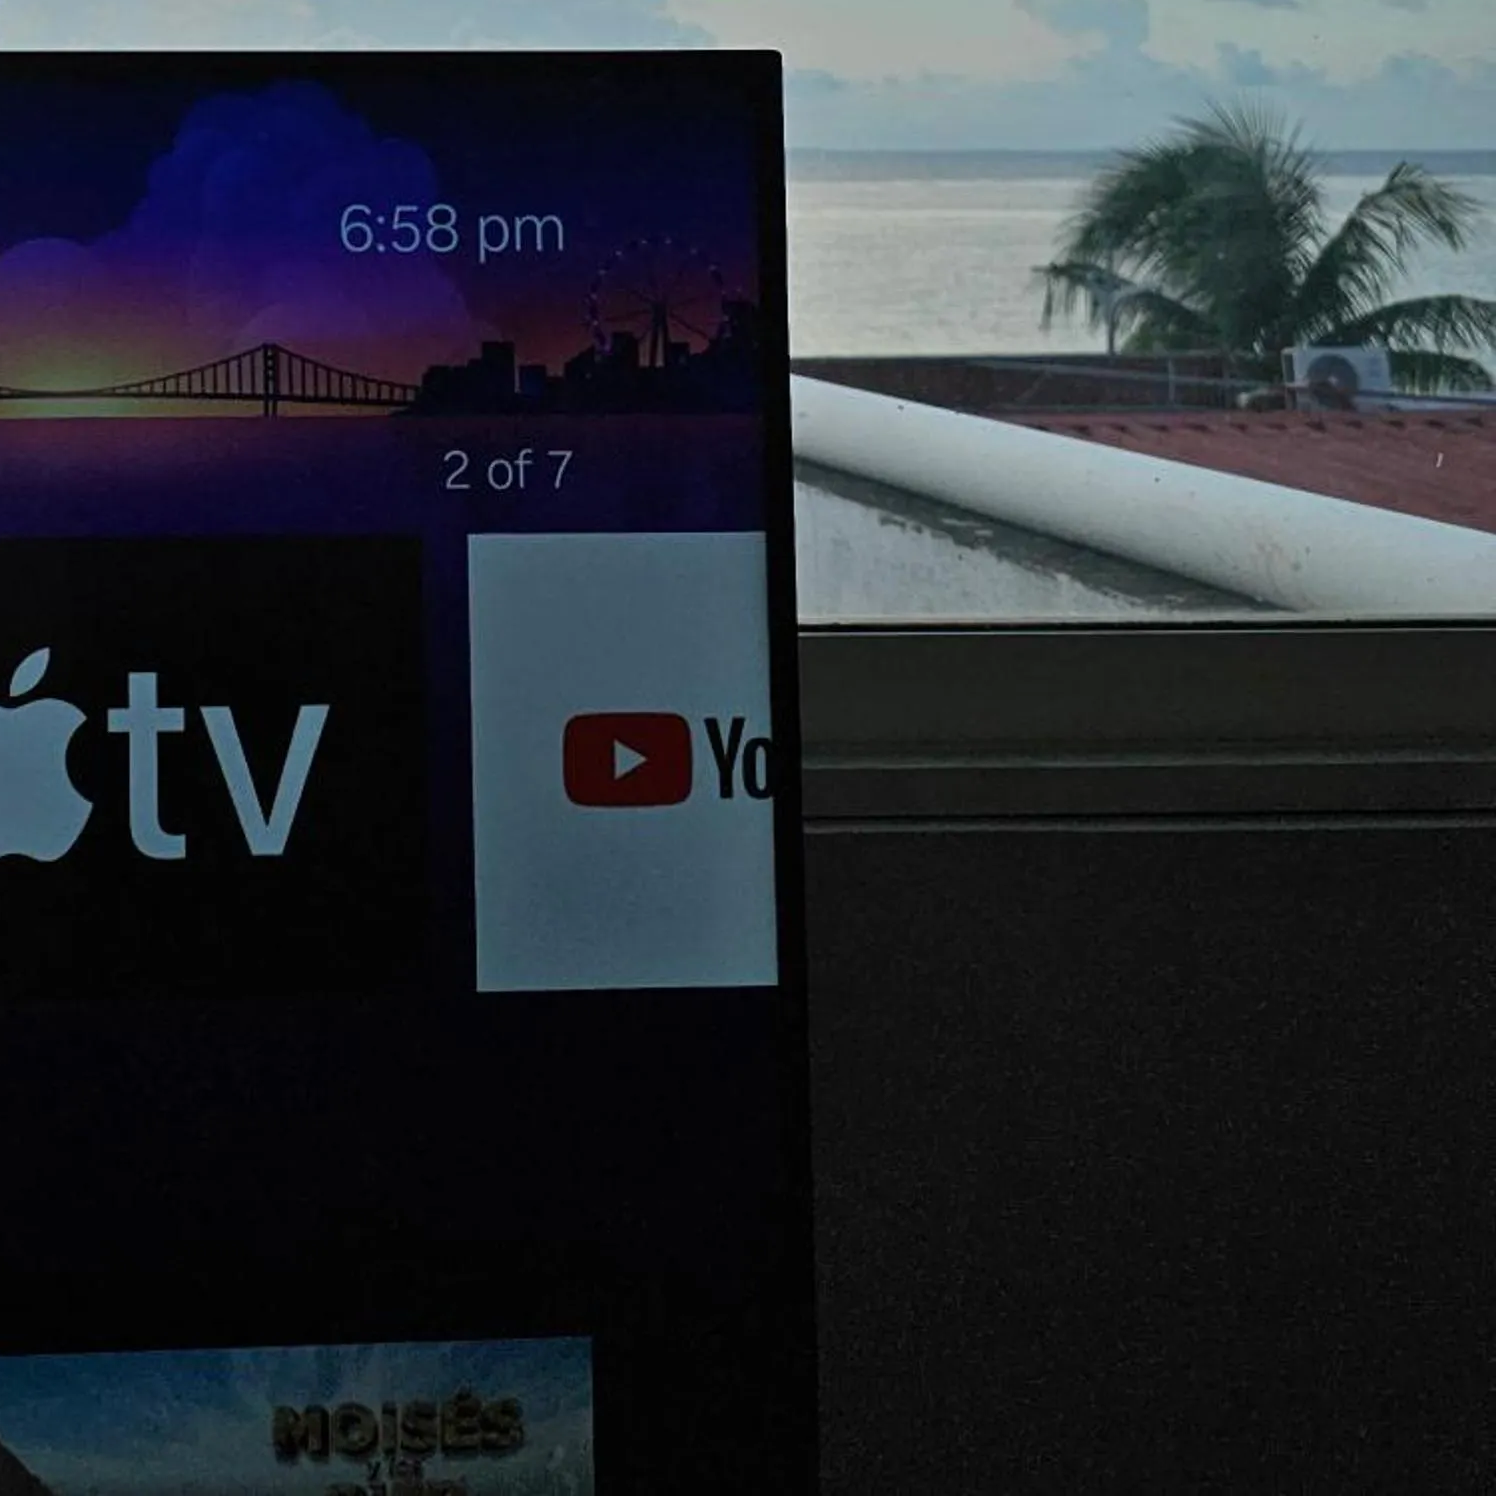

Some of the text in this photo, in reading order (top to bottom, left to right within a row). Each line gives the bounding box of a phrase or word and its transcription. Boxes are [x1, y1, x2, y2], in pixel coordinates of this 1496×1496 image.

[339, 203, 565, 264] 6:58 pm
[444, 448, 574, 491] 2 of 7
[107, 671, 331, 860] tv
